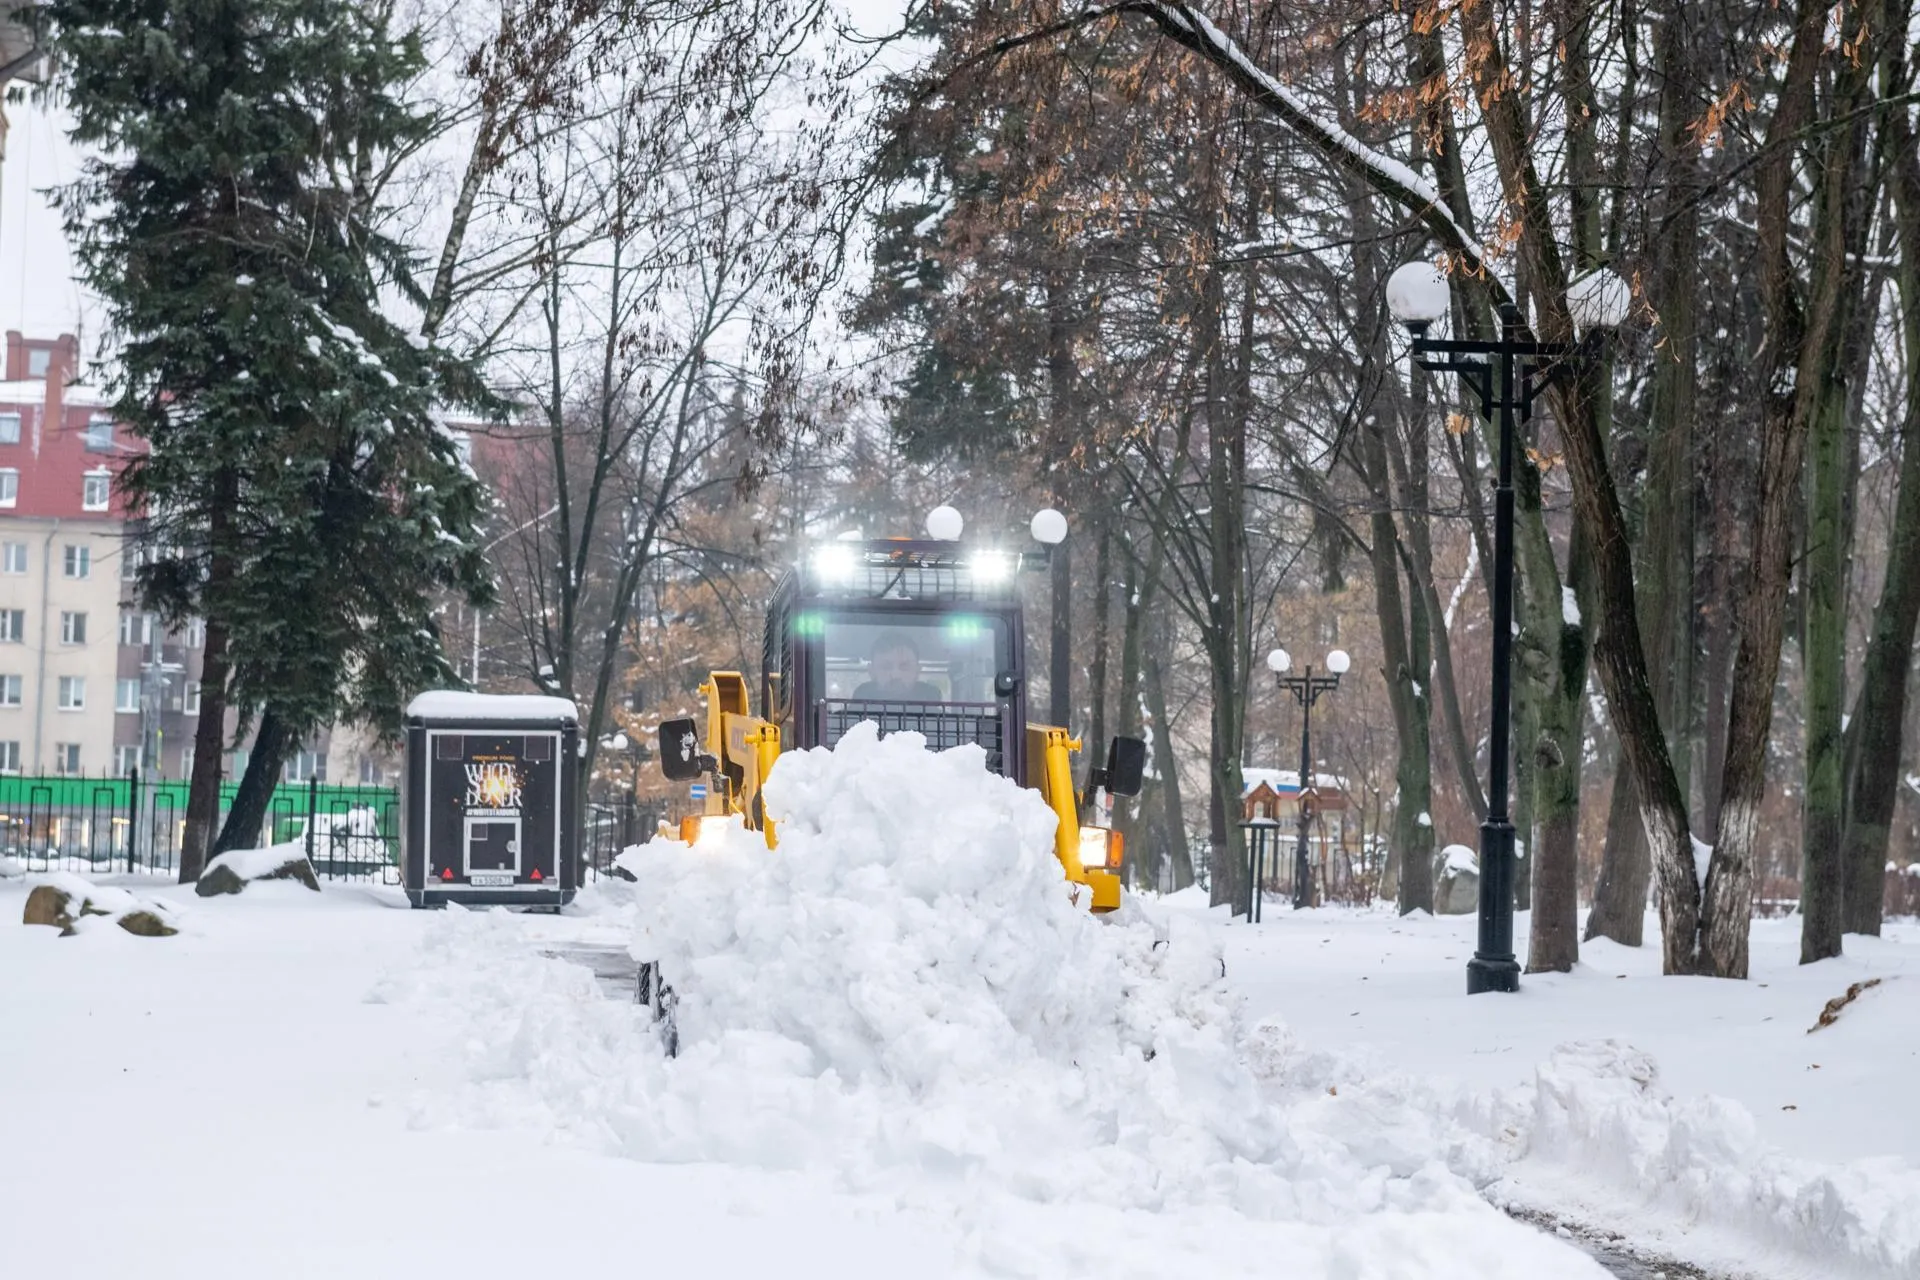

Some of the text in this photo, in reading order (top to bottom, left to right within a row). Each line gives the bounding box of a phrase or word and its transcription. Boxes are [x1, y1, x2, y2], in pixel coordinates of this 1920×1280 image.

[464, 762, 517, 783] WHITE
[467, 777, 514, 796] STAR
[465, 788, 523, 808] DONER
